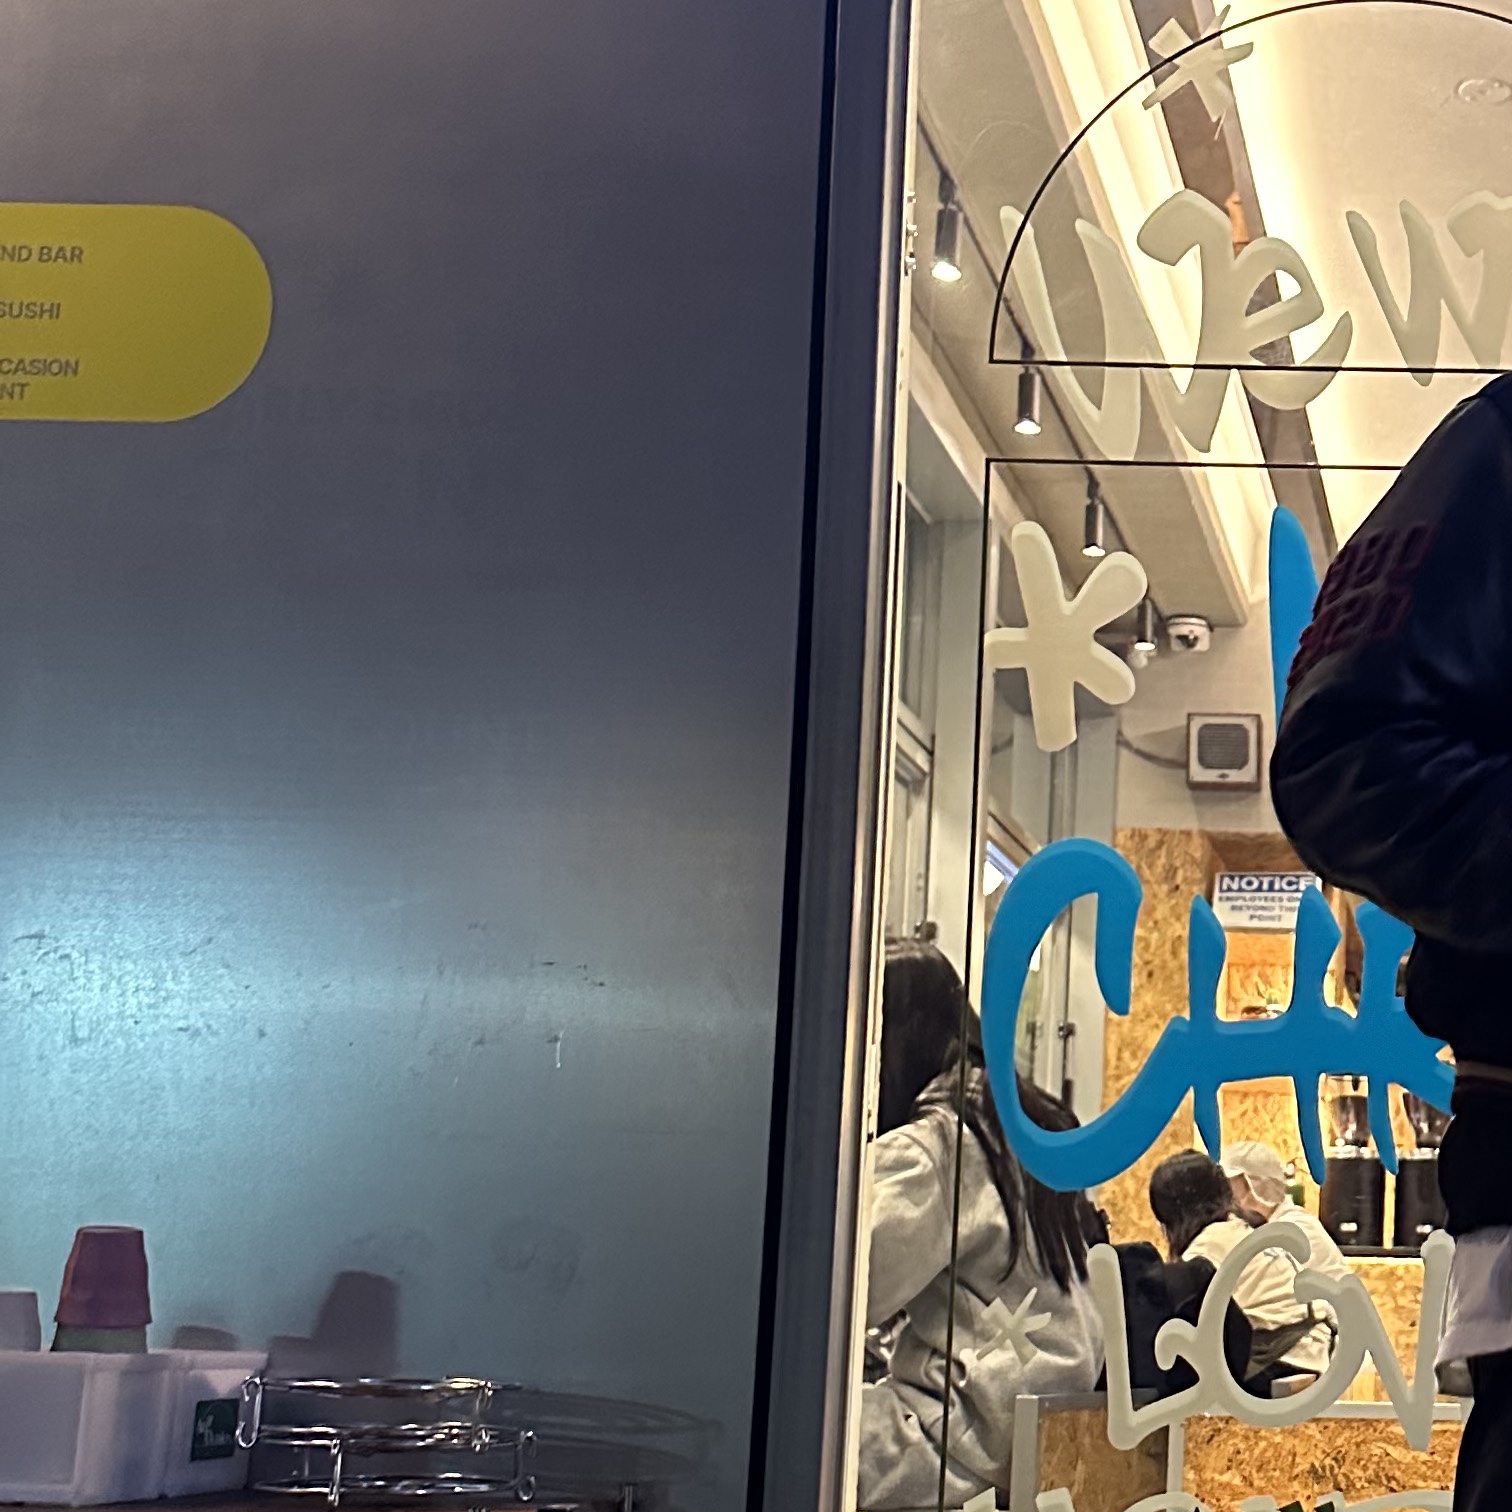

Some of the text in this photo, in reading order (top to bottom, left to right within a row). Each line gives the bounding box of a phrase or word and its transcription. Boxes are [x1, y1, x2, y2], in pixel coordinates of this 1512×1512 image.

[0, 245, 84, 264] ND BAR
[0, 358, 80, 377] CASION
